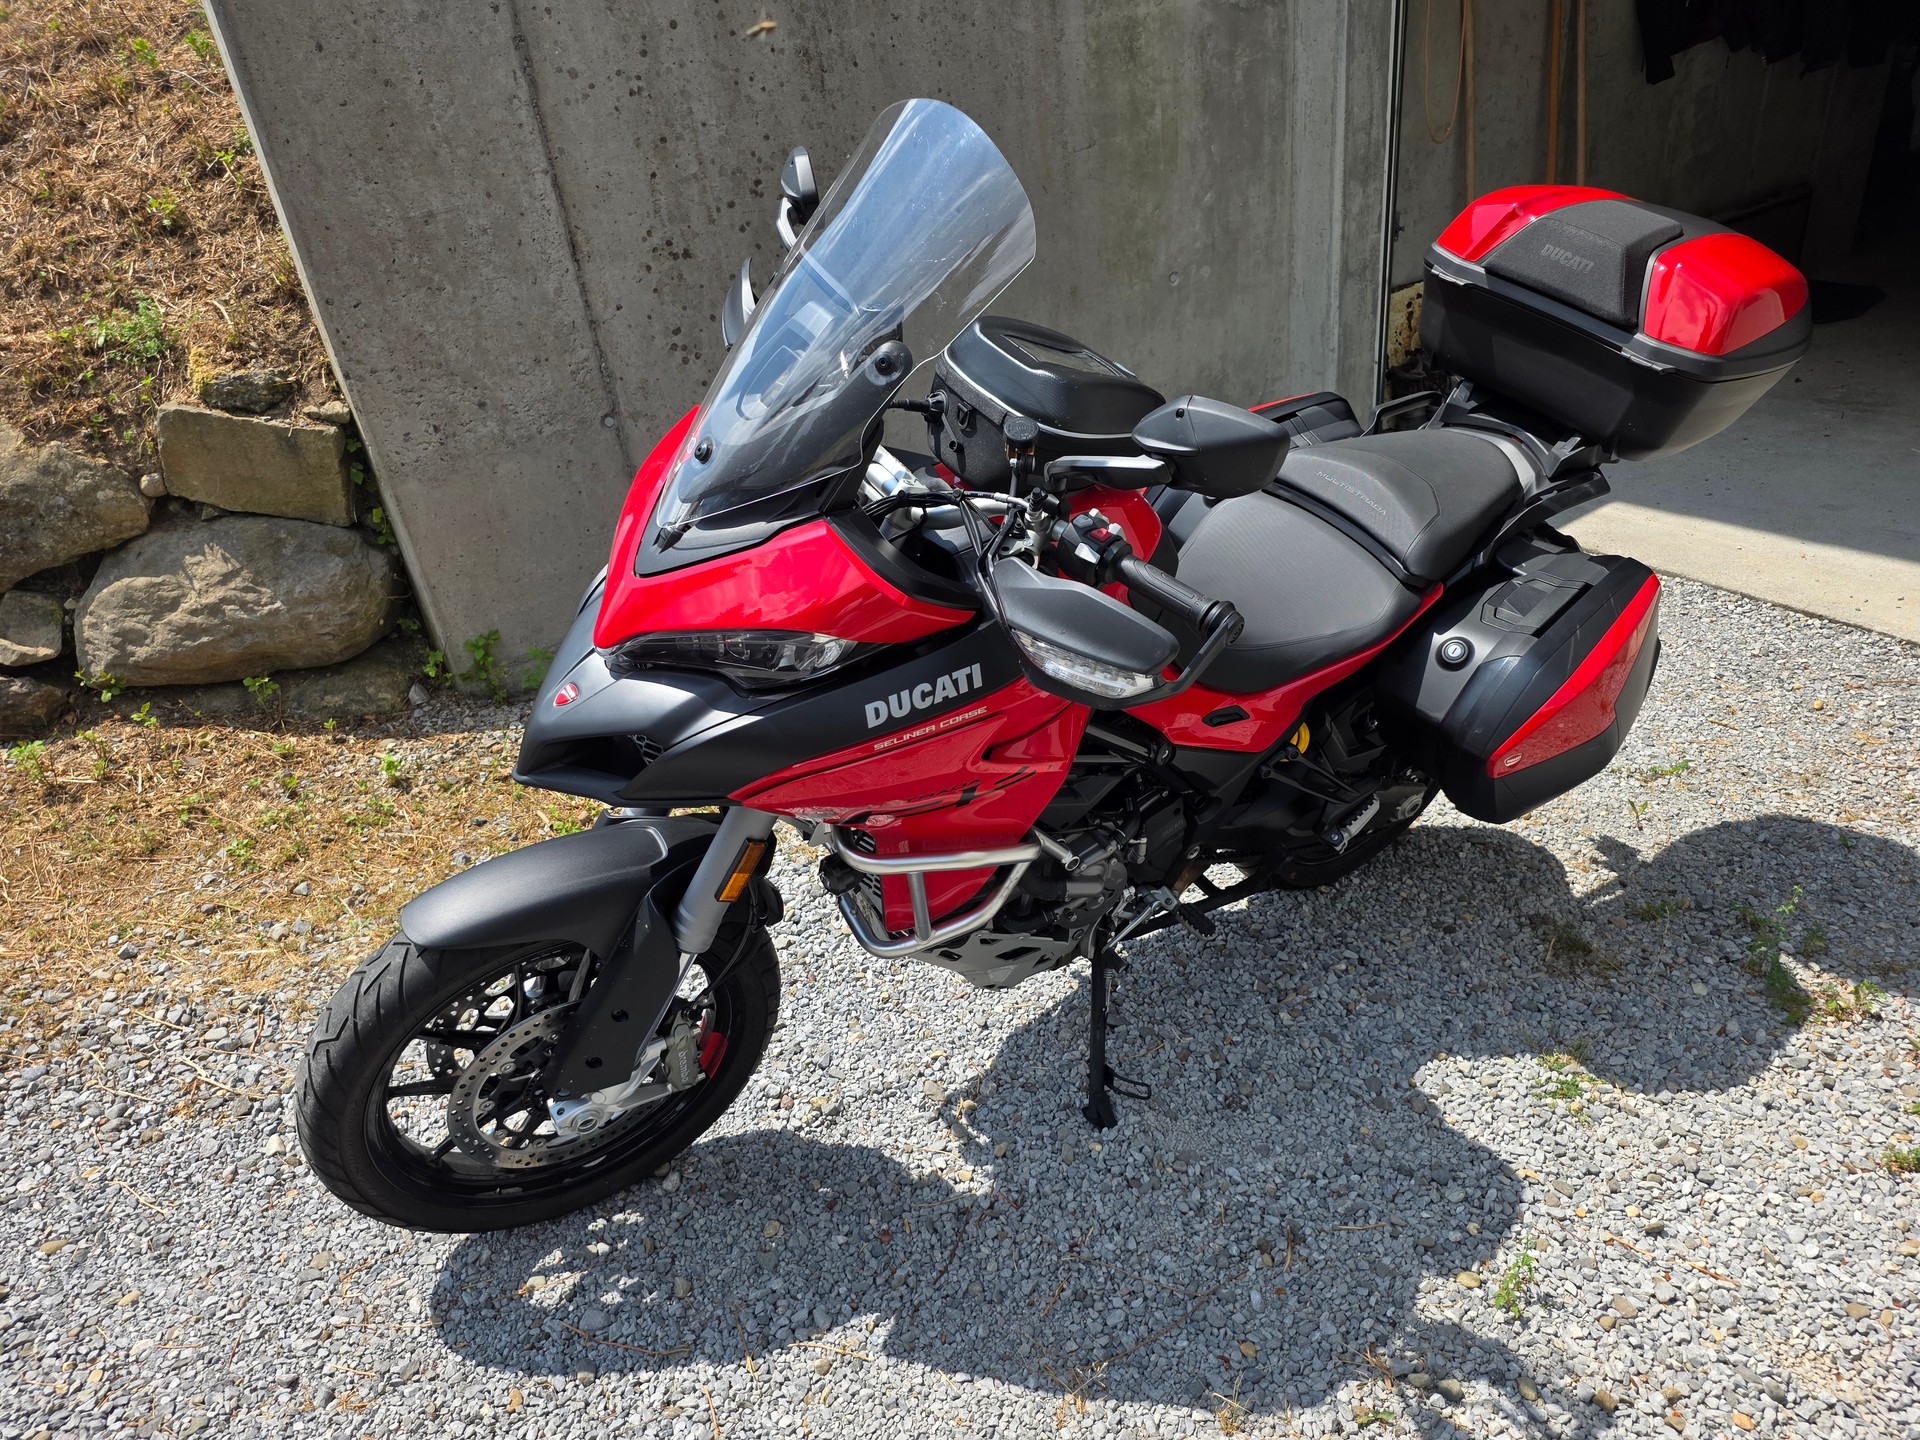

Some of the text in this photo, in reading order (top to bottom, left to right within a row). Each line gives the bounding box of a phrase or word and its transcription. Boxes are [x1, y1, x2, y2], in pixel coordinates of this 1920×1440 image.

[1541, 244, 1595, 274] DUCATI
[865, 662, 983, 729] DUCATI
[874, 705, 988, 751] SELINER CORSE
[678, 1049, 690, 1083] brembo
